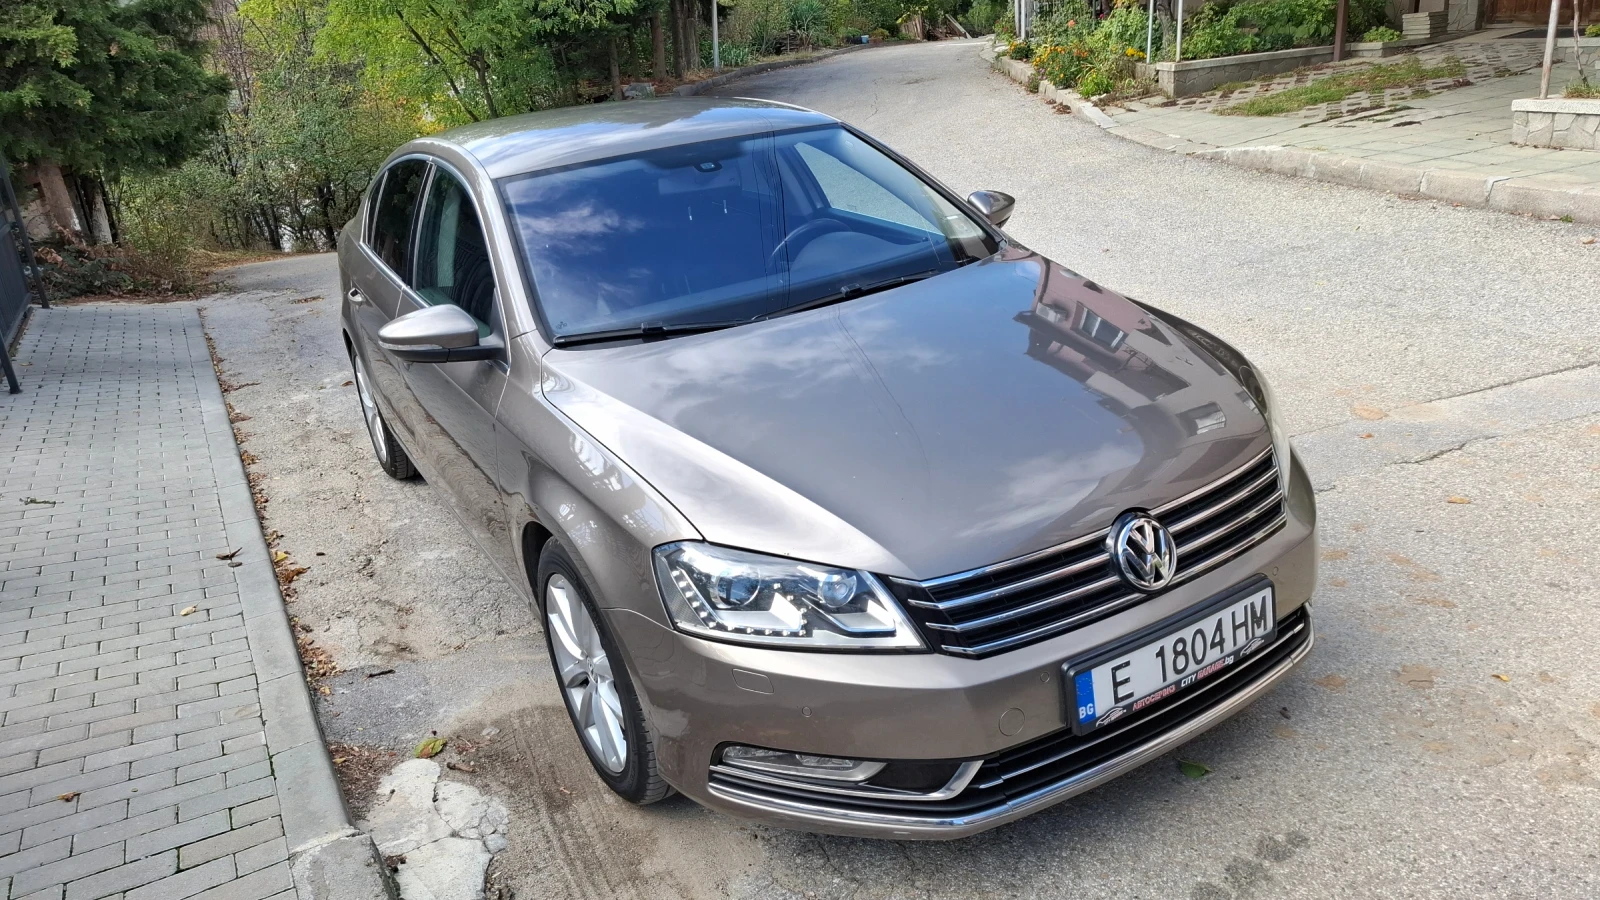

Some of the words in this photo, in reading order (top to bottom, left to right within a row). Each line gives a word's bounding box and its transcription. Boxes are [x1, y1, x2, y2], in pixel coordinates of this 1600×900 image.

[1111, 660, 1134, 705] E
[1155, 617, 1226, 683] 1804
[1231, 595, 1268, 648] HM
[1181, 673, 1197, 687] CITY
[1078, 702, 1094, 719] BG
